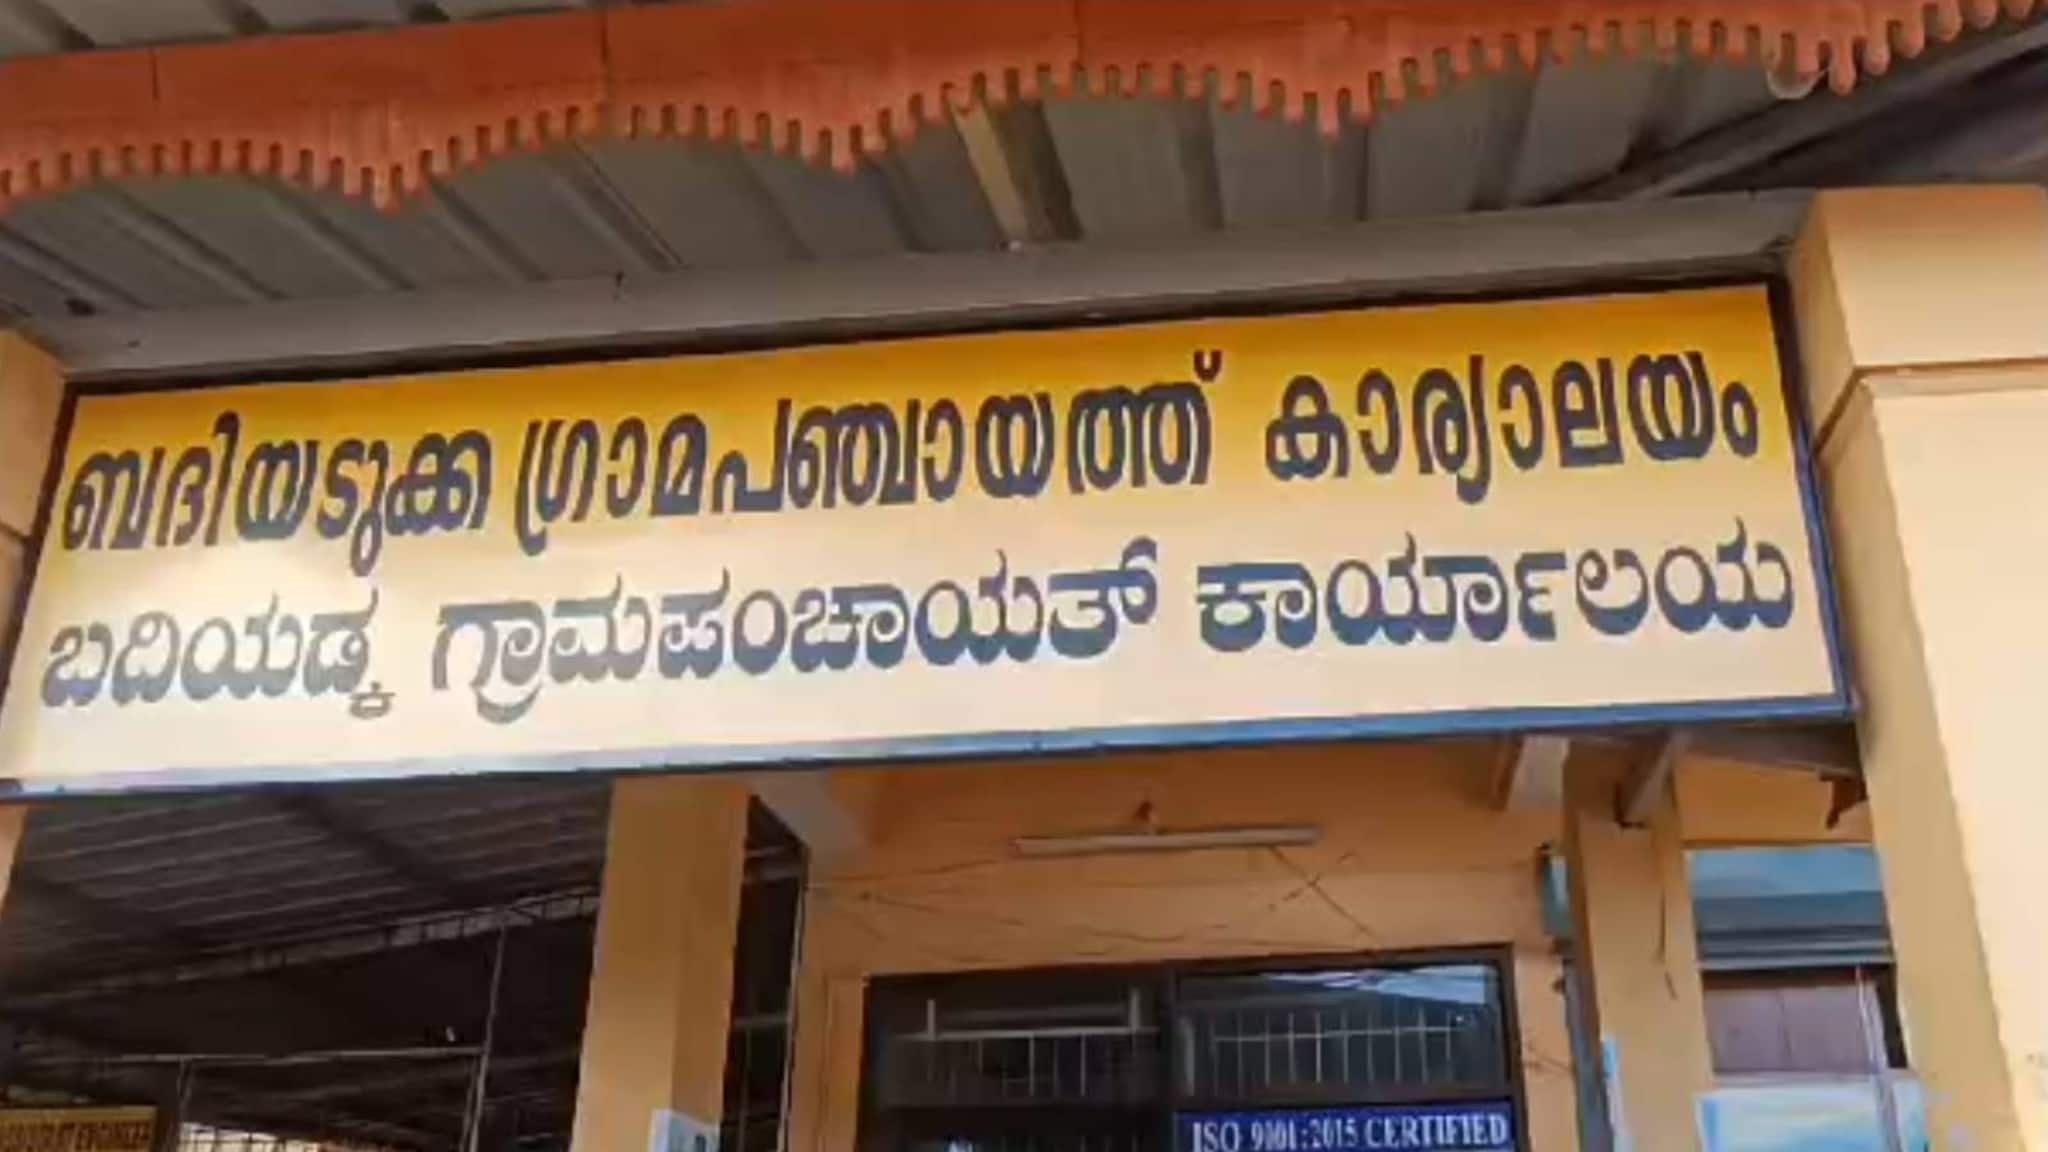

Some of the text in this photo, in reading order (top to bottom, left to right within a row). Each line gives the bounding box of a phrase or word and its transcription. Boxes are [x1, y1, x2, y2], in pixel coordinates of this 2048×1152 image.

[62, 350, 1758, 576] ബദിയടുക്ക ഗ്രാമപഞ്ചായത്ത് കാര്യാലയം
[40, 515, 1794, 724] ಬದಿಯಡ್ಕ ಗ್ರಾಮಪಂಚಾಯತ್ ಕಾರ್ಯಾಲಯ
[1192, 1121, 1241, 1152] ISO
[1365, 1112, 1508, 1147] CERTIFIED
